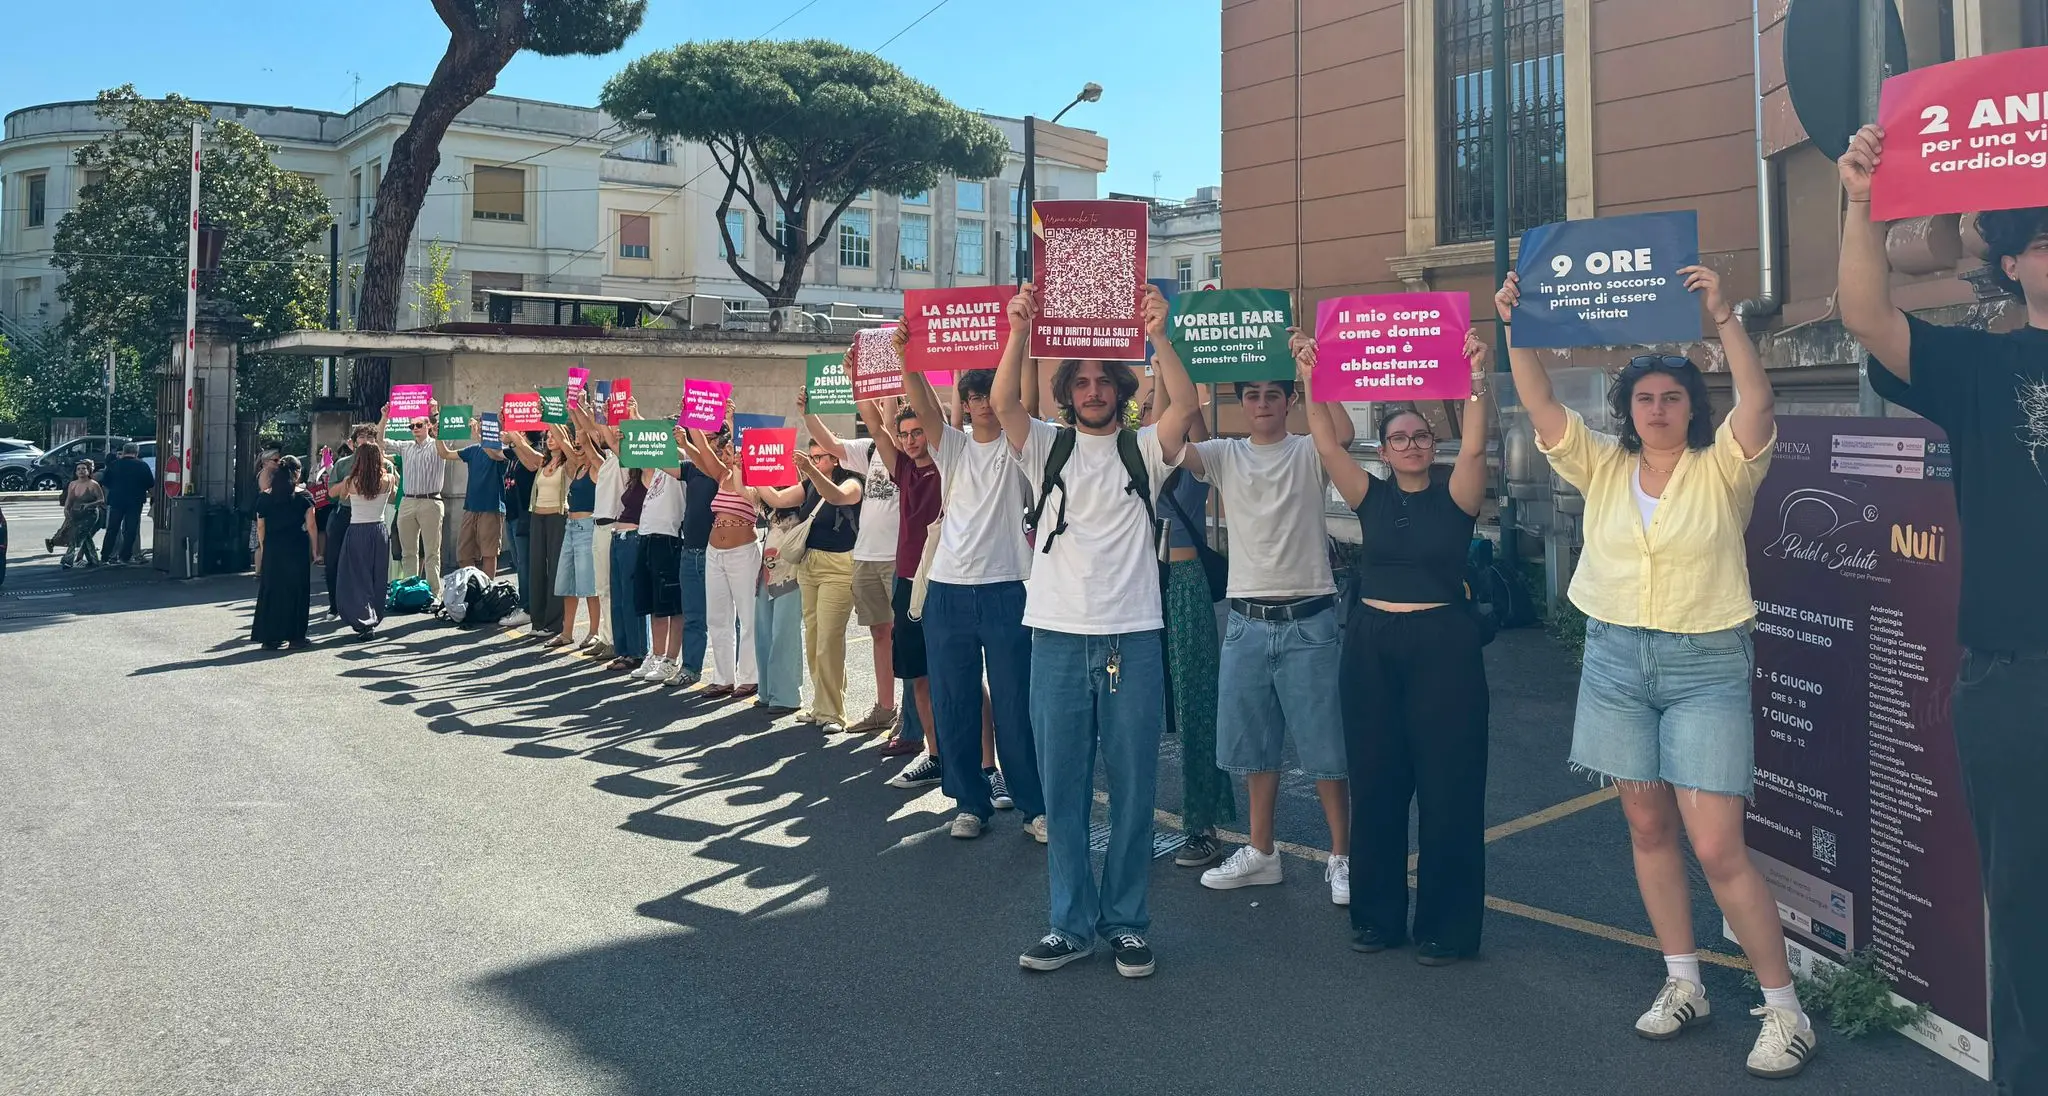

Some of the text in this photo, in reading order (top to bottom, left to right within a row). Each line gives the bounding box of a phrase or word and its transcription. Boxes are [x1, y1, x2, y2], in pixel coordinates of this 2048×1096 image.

[1919, 91, 2048, 135] 2 AN
[1921, 124, 2048, 157] per una vi
[1930, 149, 2047, 172] cardiolog
[1551, 248, 1652, 277] 9 ORE
[1540, 276, 1666, 295] in pronto soccorso
[1550, 292, 1657, 310] prima di essere
[922, 302, 1000, 317] LA SALUTE
[1338, 309, 1440, 323] Il mio corpo
[1578, 308, 1628, 320] visitata
[928, 316, 996, 329] MENTALE
[1174, 310, 1284, 327] VORREI FARE
[928, 330, 996, 343] È SALUTE
[1038, 326, 1139, 337] PER UN DIRITTO ALLA SALUTE
[1185, 325, 1272, 341] MEDICINA
[1338, 325, 1440, 340] come donna
[955, 342, 999, 351] investirci!
[1046, 337, 1130, 347] E AL LAVORO DIGNITOSO
[1258, 341, 1263, 350] il
[1366, 341, 1413, 354] non è
[1192, 353, 1266, 364] semestre filtro
[1341, 358, 1438, 371] abbastanza
[823, 365, 844, 375] 683
[814, 376, 852, 386] DENUN
[1355, 374, 1424, 387] studiato
[628, 432, 668, 441] 1 ANNO
[749, 444, 784, 455] 2 ANNI
[1774, 442, 1810, 454] APIENZA
[1781, 533, 1881, 570] Padel e Salute
[1753, 600, 1854, 631] SULENZE GRATUITE
[1870, 605, 1903, 617] Andrologia
[1870, 615, 1902, 626] Angiologia
[1755, 621, 1832, 647] NGRESSO LIBERO
[1870, 624, 1904, 637] Cardiologia
[1870, 634, 1926, 651] Chirurgia Generale
[1870, 644, 1923, 660] Chirurgia Plastica
[1870, 654, 1924, 671] Chirurgia Toracica
[1869, 663, 1928, 682] Chirurgia Vascolare
[1869, 673, 1903, 687] Counseling
[1756, 668, 1762, 678] 5
[1771, 672, 1777, 682] 6
[1780, 674, 1823, 695] GIUGNO
[1869, 682, 1903, 695] Psicologico
[1772, 692, 1786, 702] ORE
[1798, 700, 1806, 708] 18
[1869, 692, 1910, 707] Dermatologia
[1869, 701, 1907, 717] Diabetologia
[1762, 706, 1813, 731] 7 GIUGNO
[1869, 711, 1915, 729] Endocrinologia
[1869, 721, 1893, 732] Fisiatria
[1771, 730, 1785, 741] ORE
[1798, 738, 1805, 747] 12
[1869, 731, 1924, 752] Gastroenterologia
[1869, 740, 1895, 753] Geriatria
[1870, 750, 1905, 766] Ginecologia
[1870, 759, 1932, 785] Immunologia Clinica
[1753, 767, 1828, 802] SAPIENZA SPORT
[1870, 769, 1938, 797] Ipertensione Arteriosa
[1870, 780, 1894, 792] Malattie
[1870, 788, 1932, 816] Medicina dello Sport
[1870, 798, 1921, 822] Medicina Interna
[1870, 808, 1901, 824] Nefrologia
[1746, 811, 1801, 840] padelesalute.it
[1871, 818, 1903, 835] Neurologia
[1871, 827, 1924, 853] Nutrizione Clinica
[1871, 837, 1900, 853] Oculistica
[1872, 867, 1901, 884] Ortopedia
[1872, 876, 1932, 907] Otorinolaringoiatria
[1872, 886, 1899, 902] Pediatria
[1872, 896, 1912, 918] Pneumologia
[1872, 906, 1906, 926] Proctologia
[1873, 915, 1904, 935] Radiologia
[1873, 935, 1909, 957] Salute Orale
